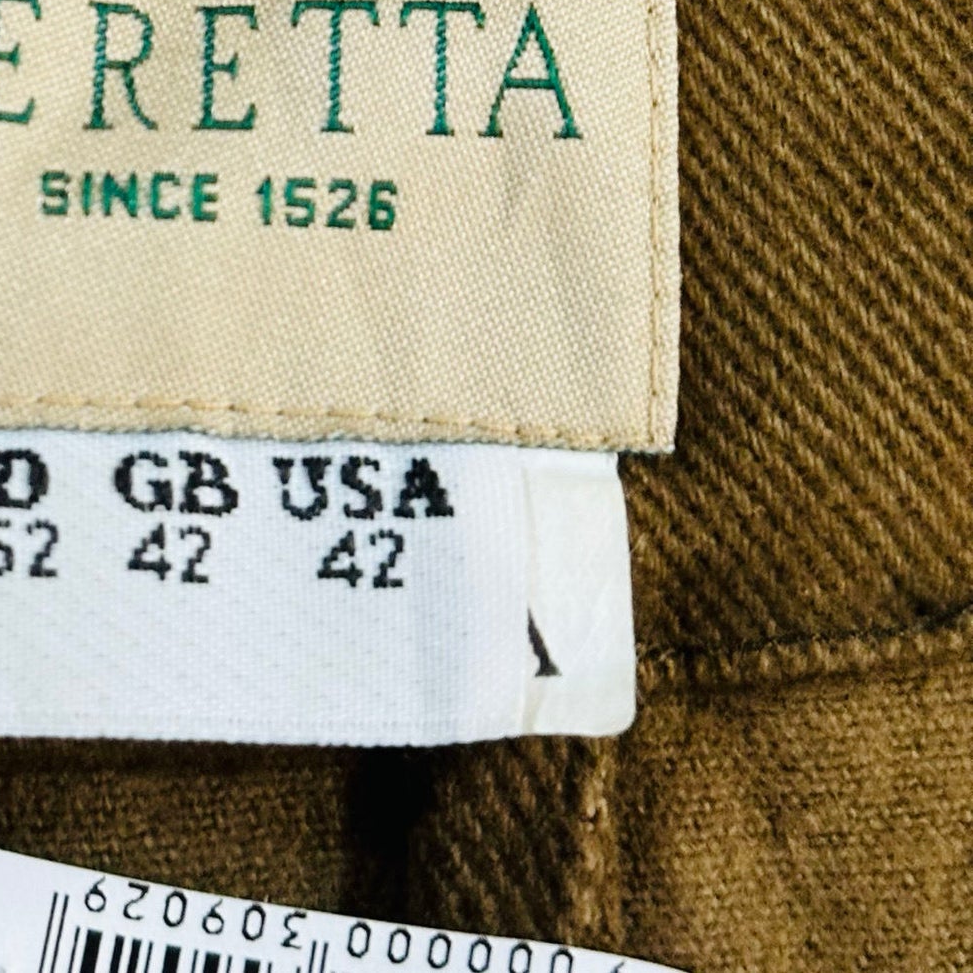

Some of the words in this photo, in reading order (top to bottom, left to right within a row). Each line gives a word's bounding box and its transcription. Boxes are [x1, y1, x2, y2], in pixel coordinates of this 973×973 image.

[42, 172, 217, 222] SINCE
[256, 177, 397, 231] 1526
[114, 451, 239, 517] GB
[273, 455, 455, 520] USA
[128, 524, 210, 584] 42
[317, 530, 404, 589] 42
